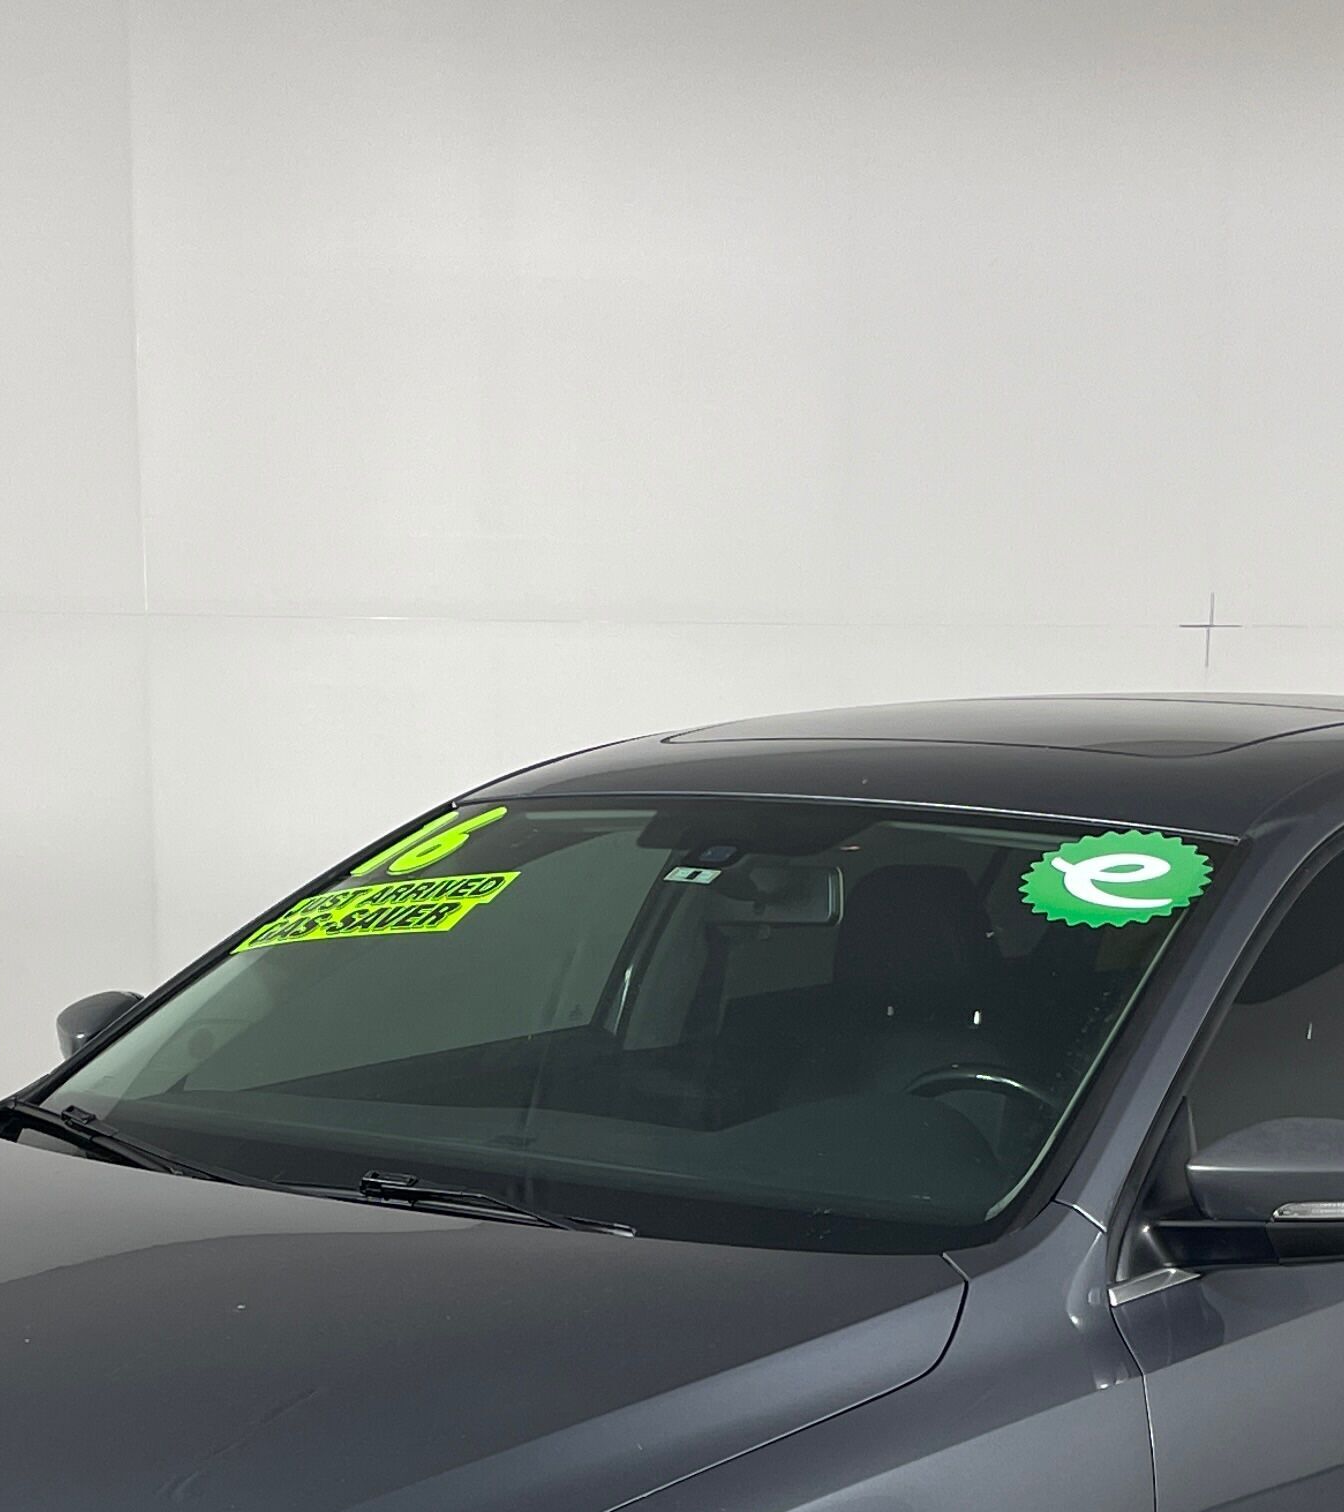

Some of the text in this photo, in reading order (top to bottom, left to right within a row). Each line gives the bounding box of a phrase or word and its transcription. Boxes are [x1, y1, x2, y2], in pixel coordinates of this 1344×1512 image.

[350, 806, 507, 876] 16
[283, 876, 507, 918] JUST ARRIVED
